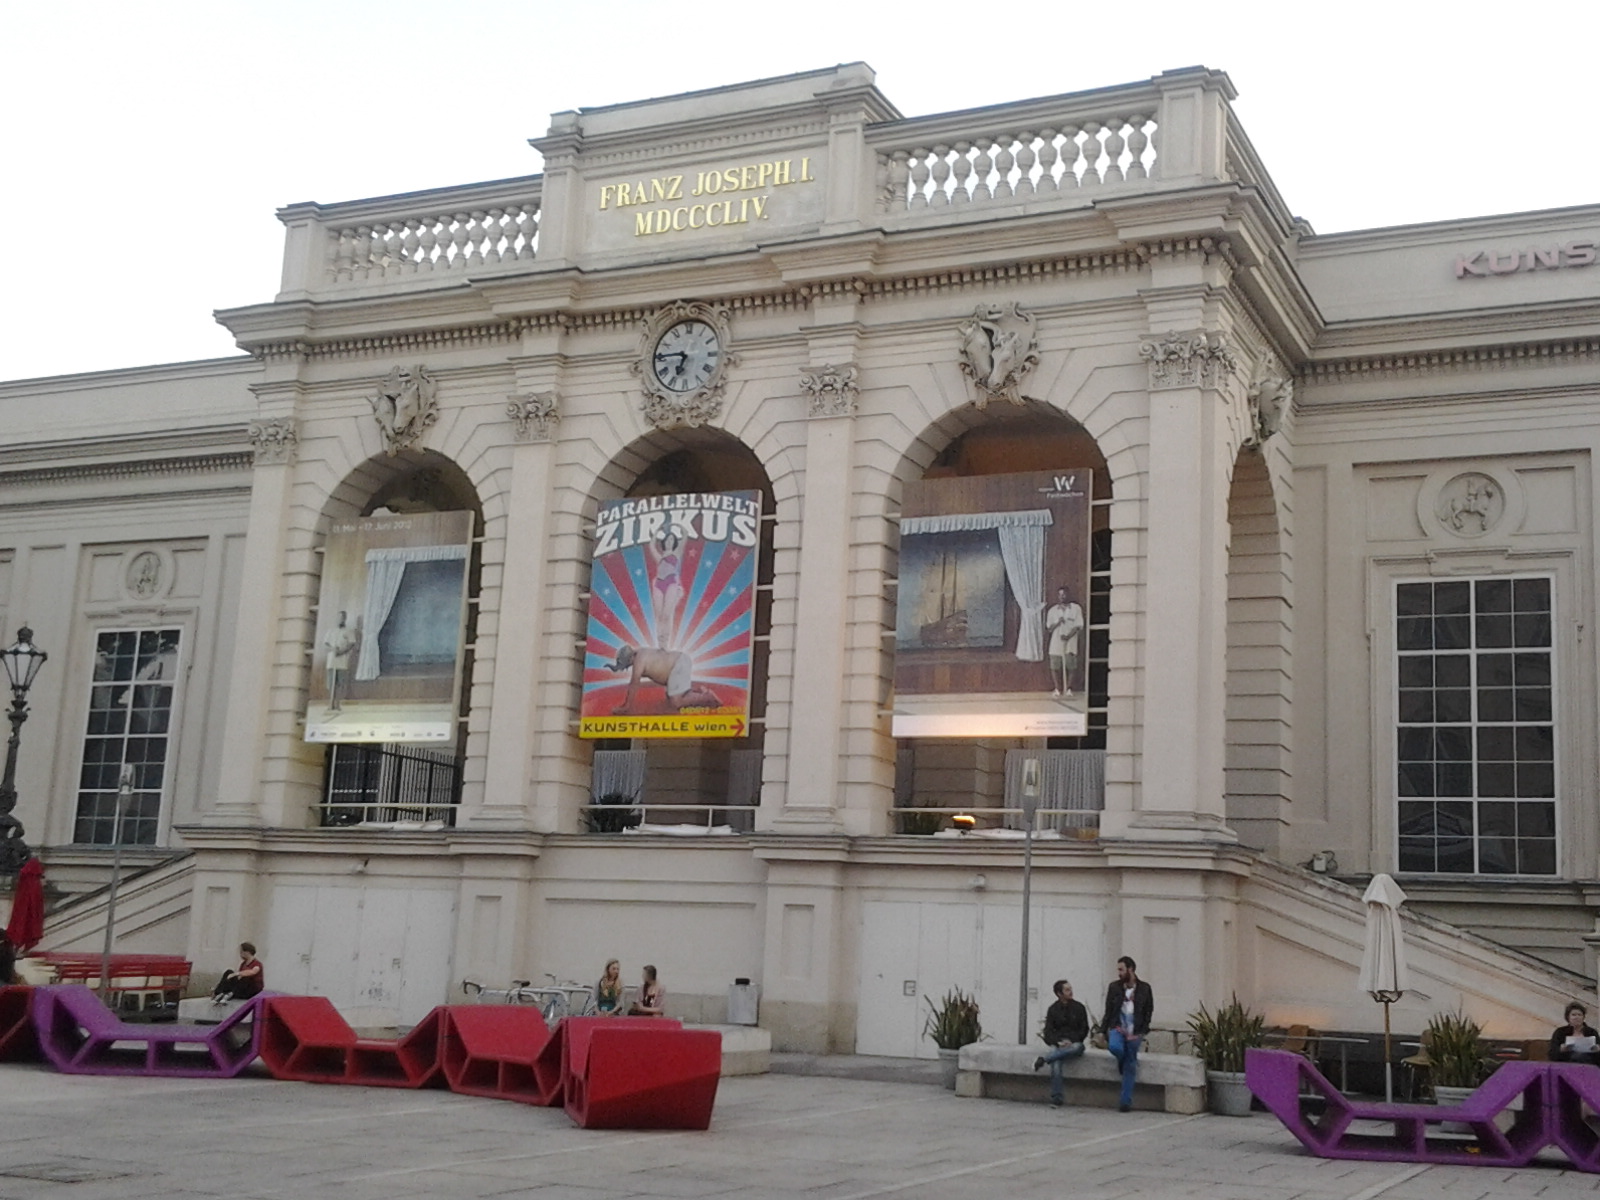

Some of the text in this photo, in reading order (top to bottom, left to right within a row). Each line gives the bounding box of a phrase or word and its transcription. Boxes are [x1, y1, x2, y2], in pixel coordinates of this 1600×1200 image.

[598, 175, 683, 211] FRANZ
[597, 493, 758, 526] PARALLELWELT
[593, 509, 757, 558] ZIRKUS
[583, 721, 727, 733] KUNSTHALLE wien
